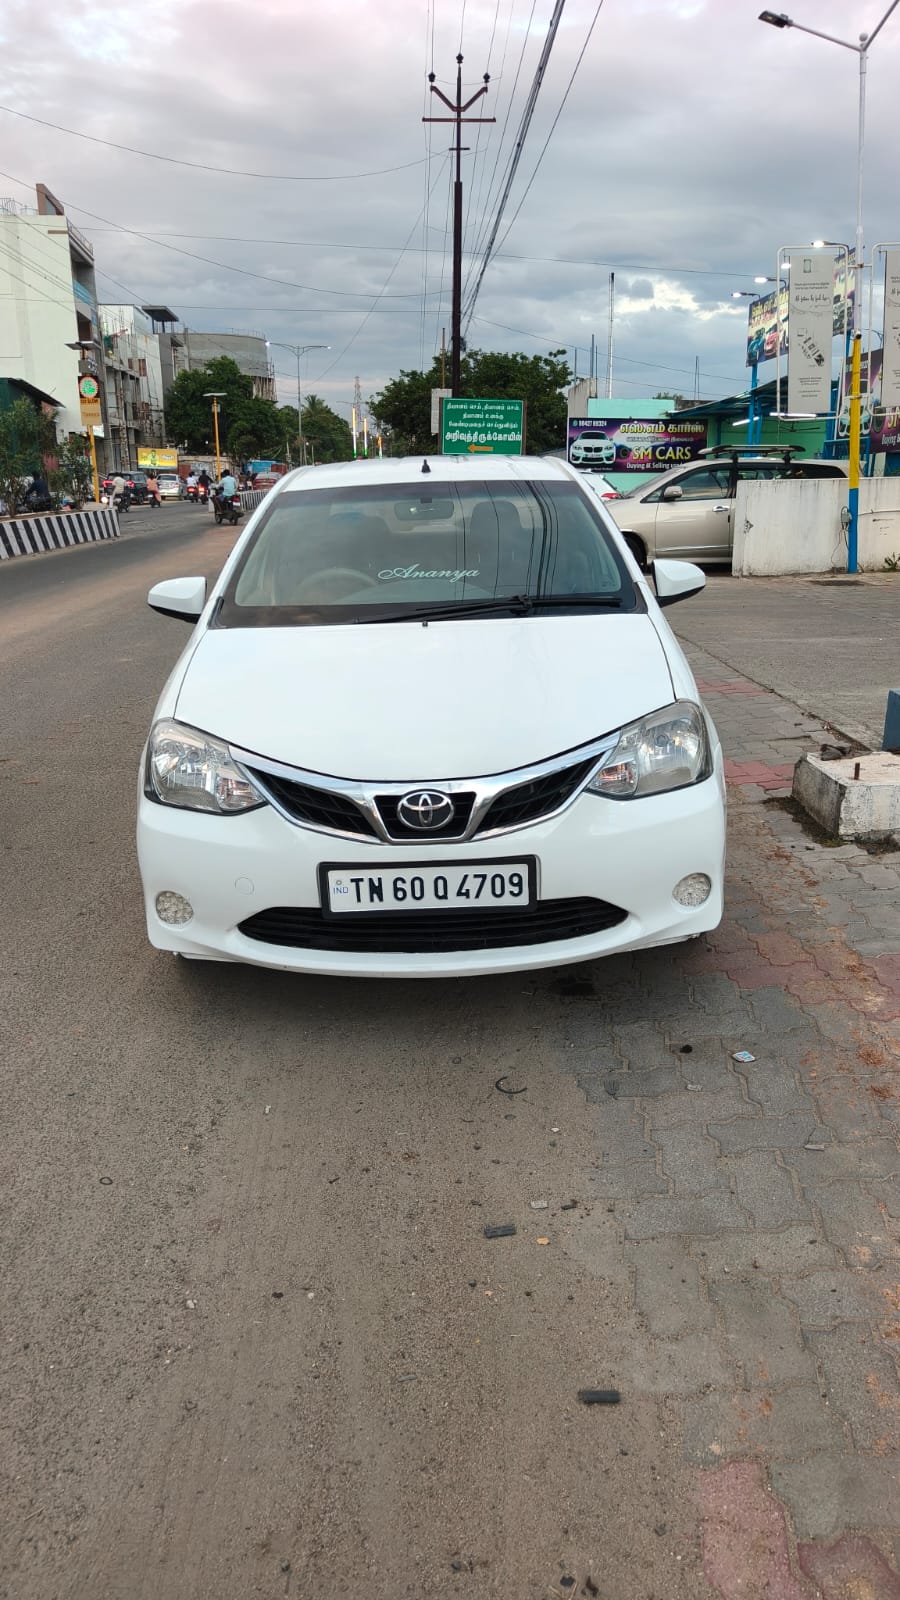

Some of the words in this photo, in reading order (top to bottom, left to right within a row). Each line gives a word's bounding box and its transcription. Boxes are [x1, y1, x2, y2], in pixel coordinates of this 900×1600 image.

[632, 446, 652, 460] SM
[655, 446, 691, 460] CARS
[626, 462, 645, 470] Buying
[652, 462, 670, 470] Selling
[377, 563, 480, 583] Ananya
[333, 886, 349, 895] IND
[350, 877, 384, 903] TN
[392, 876, 425, 901] 60
[433, 875, 449, 900] Q
[456, 872, 524, 900] 4709
